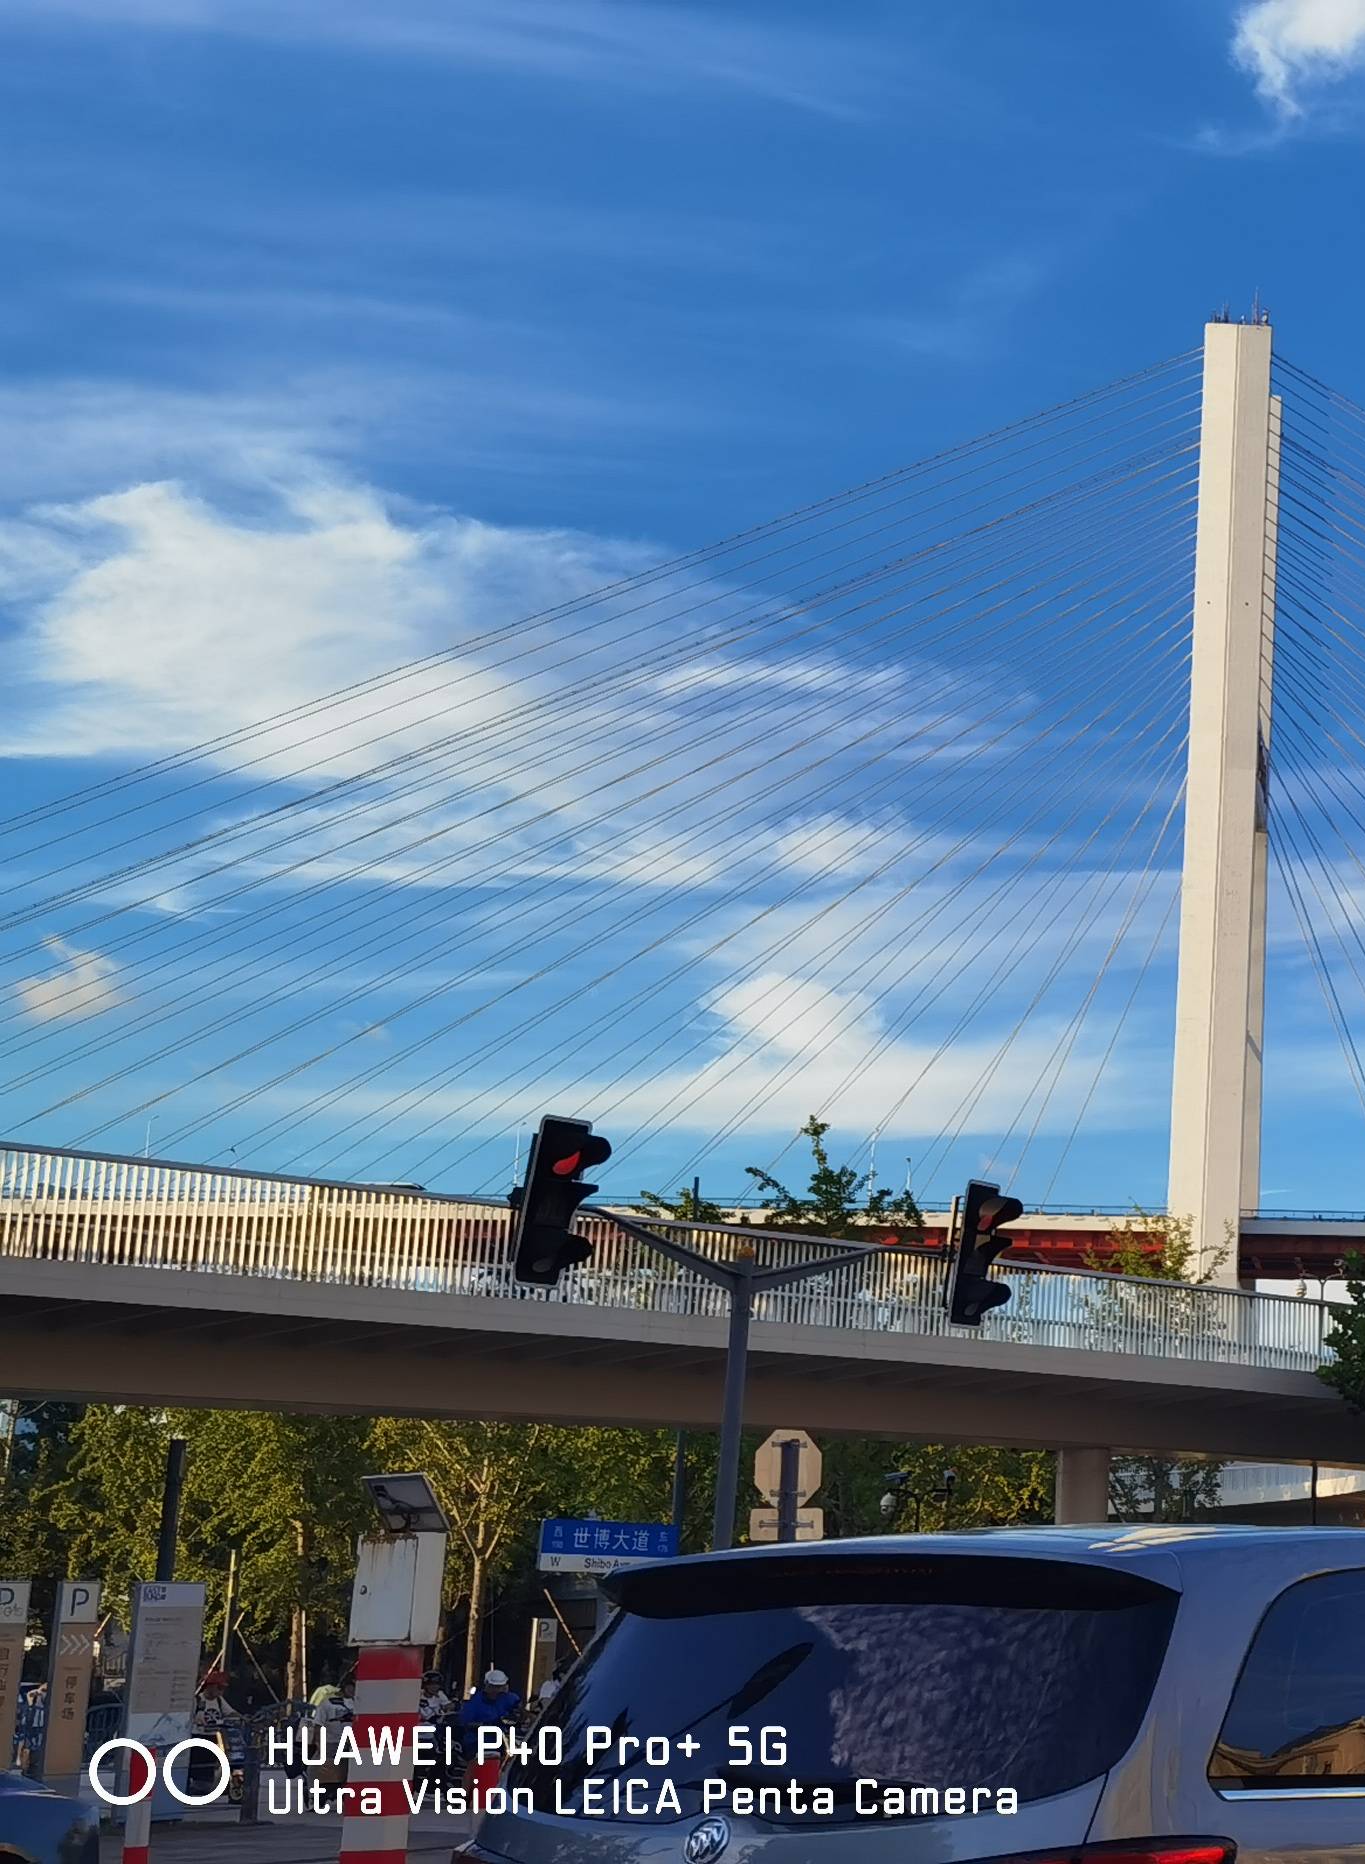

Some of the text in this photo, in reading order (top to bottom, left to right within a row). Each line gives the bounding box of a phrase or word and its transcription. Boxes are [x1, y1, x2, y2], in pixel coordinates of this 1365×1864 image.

[573, 1527, 651, 1552] 世博大道
[550, 1556, 561, 1566] W
[70, 1587, 90, 1617] P
[62, 1676, 77, 1721] 停车场
